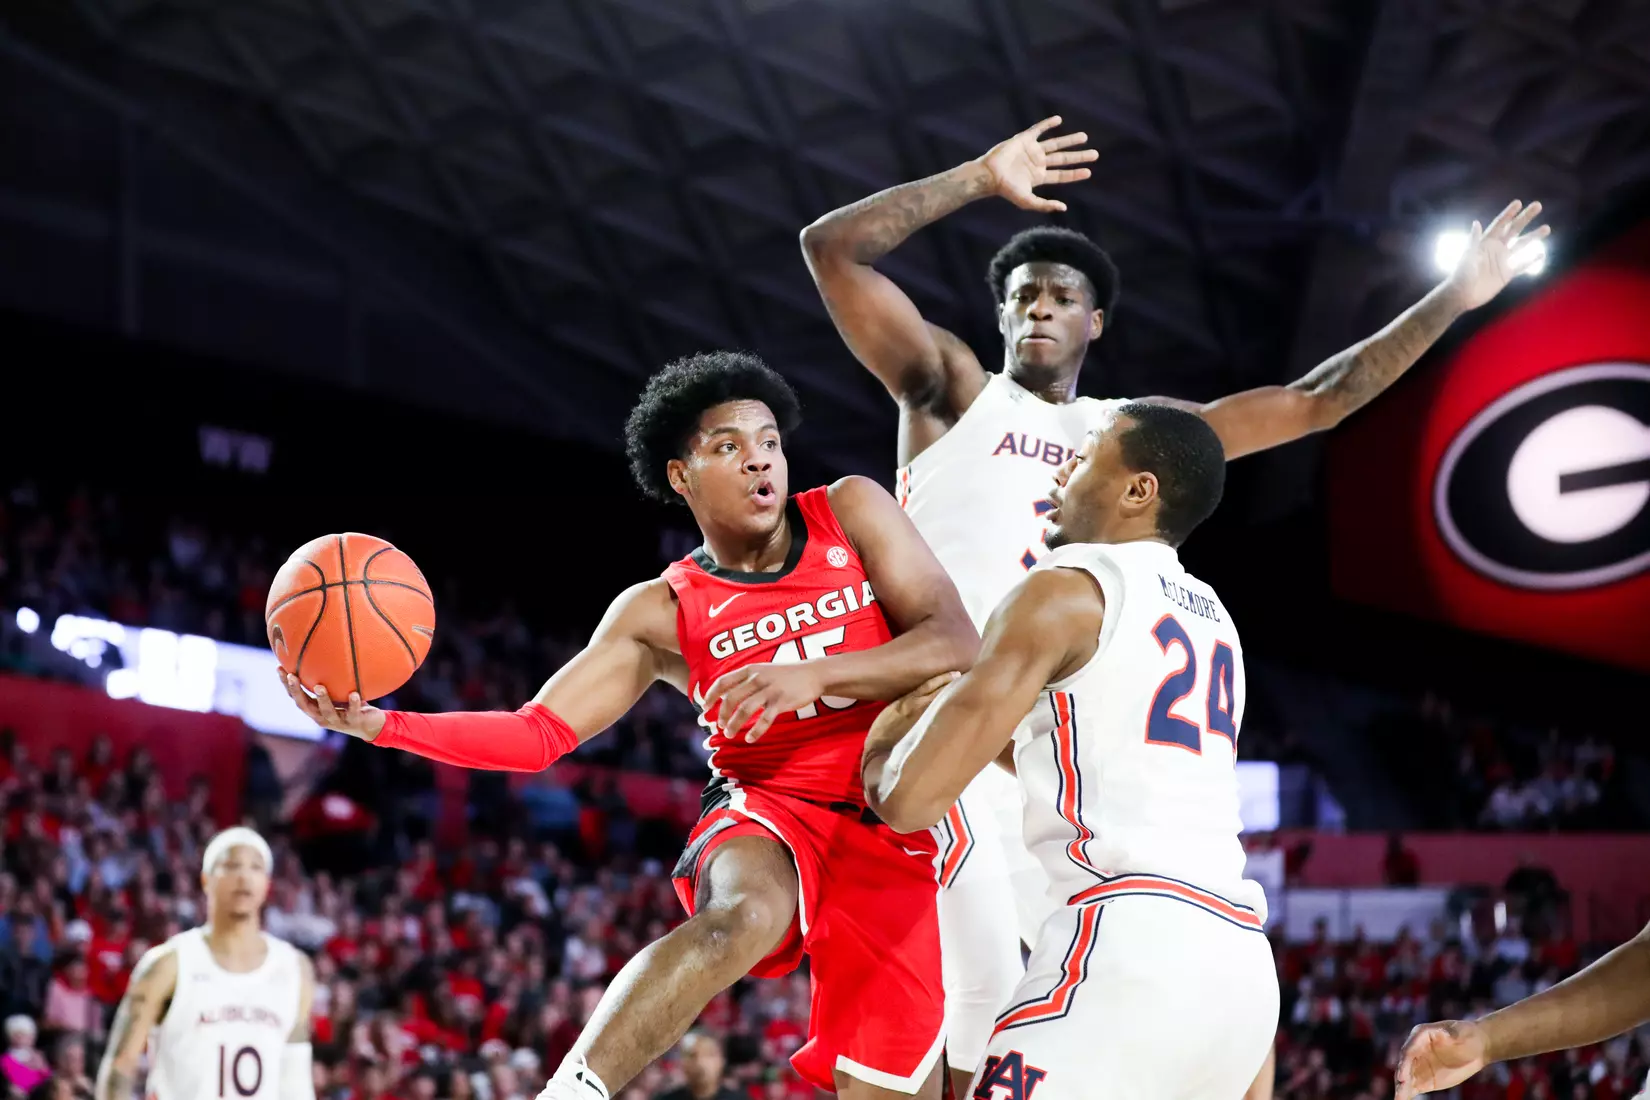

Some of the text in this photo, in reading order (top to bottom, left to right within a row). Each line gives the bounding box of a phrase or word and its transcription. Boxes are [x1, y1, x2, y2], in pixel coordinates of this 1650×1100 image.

[828, 548, 848, 566] SEC
[708, 580, 876, 660] GEORGIA
[1144, 613, 1237, 756] 24
[218, 1044, 263, 1098] 10
